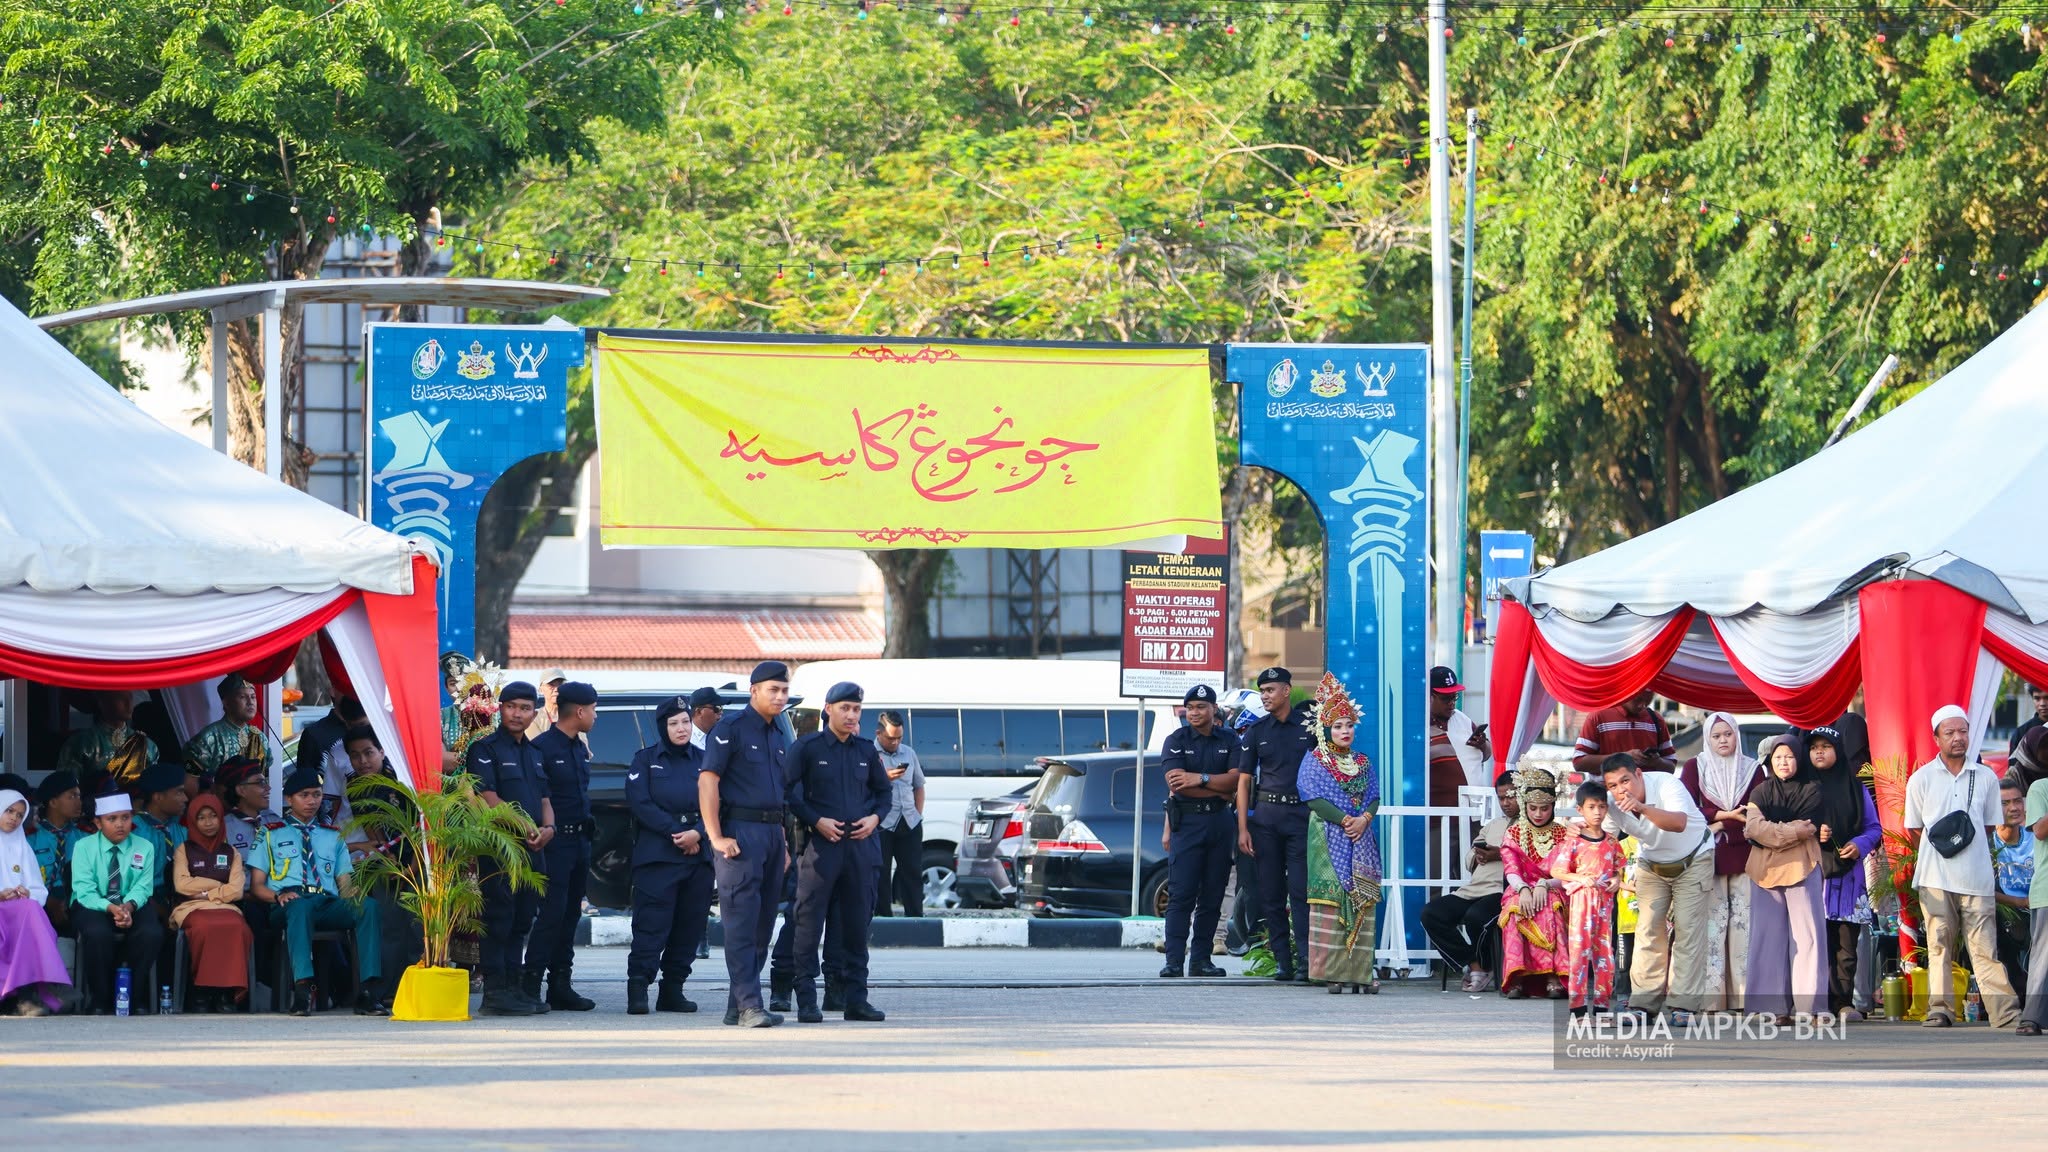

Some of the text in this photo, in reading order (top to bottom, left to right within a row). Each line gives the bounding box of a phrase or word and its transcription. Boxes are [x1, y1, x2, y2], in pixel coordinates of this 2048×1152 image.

[1157, 554, 1195, 565] TEMPAT
[1129, 565, 1223, 577] LETAK KENDERAAN
[1132, 580, 1167, 588] PERBADANAN
[1135, 595, 1215, 606] WAKTU OPERASI
[1129, 608, 1145, 616] 6.30
[1146, 608, 1165, 616] PAGI
[1170, 609, 1187, 617] 6.00
[1189, 610, 1220, 618] PETANG
[1140, 616, 1169, 624] (SABTU
[1175, 617, 1209, 626] KHAMIS)
[1134, 626, 1214, 636] KADAR BAYARAN
[1143, 642, 1204, 661] RM 2.00
